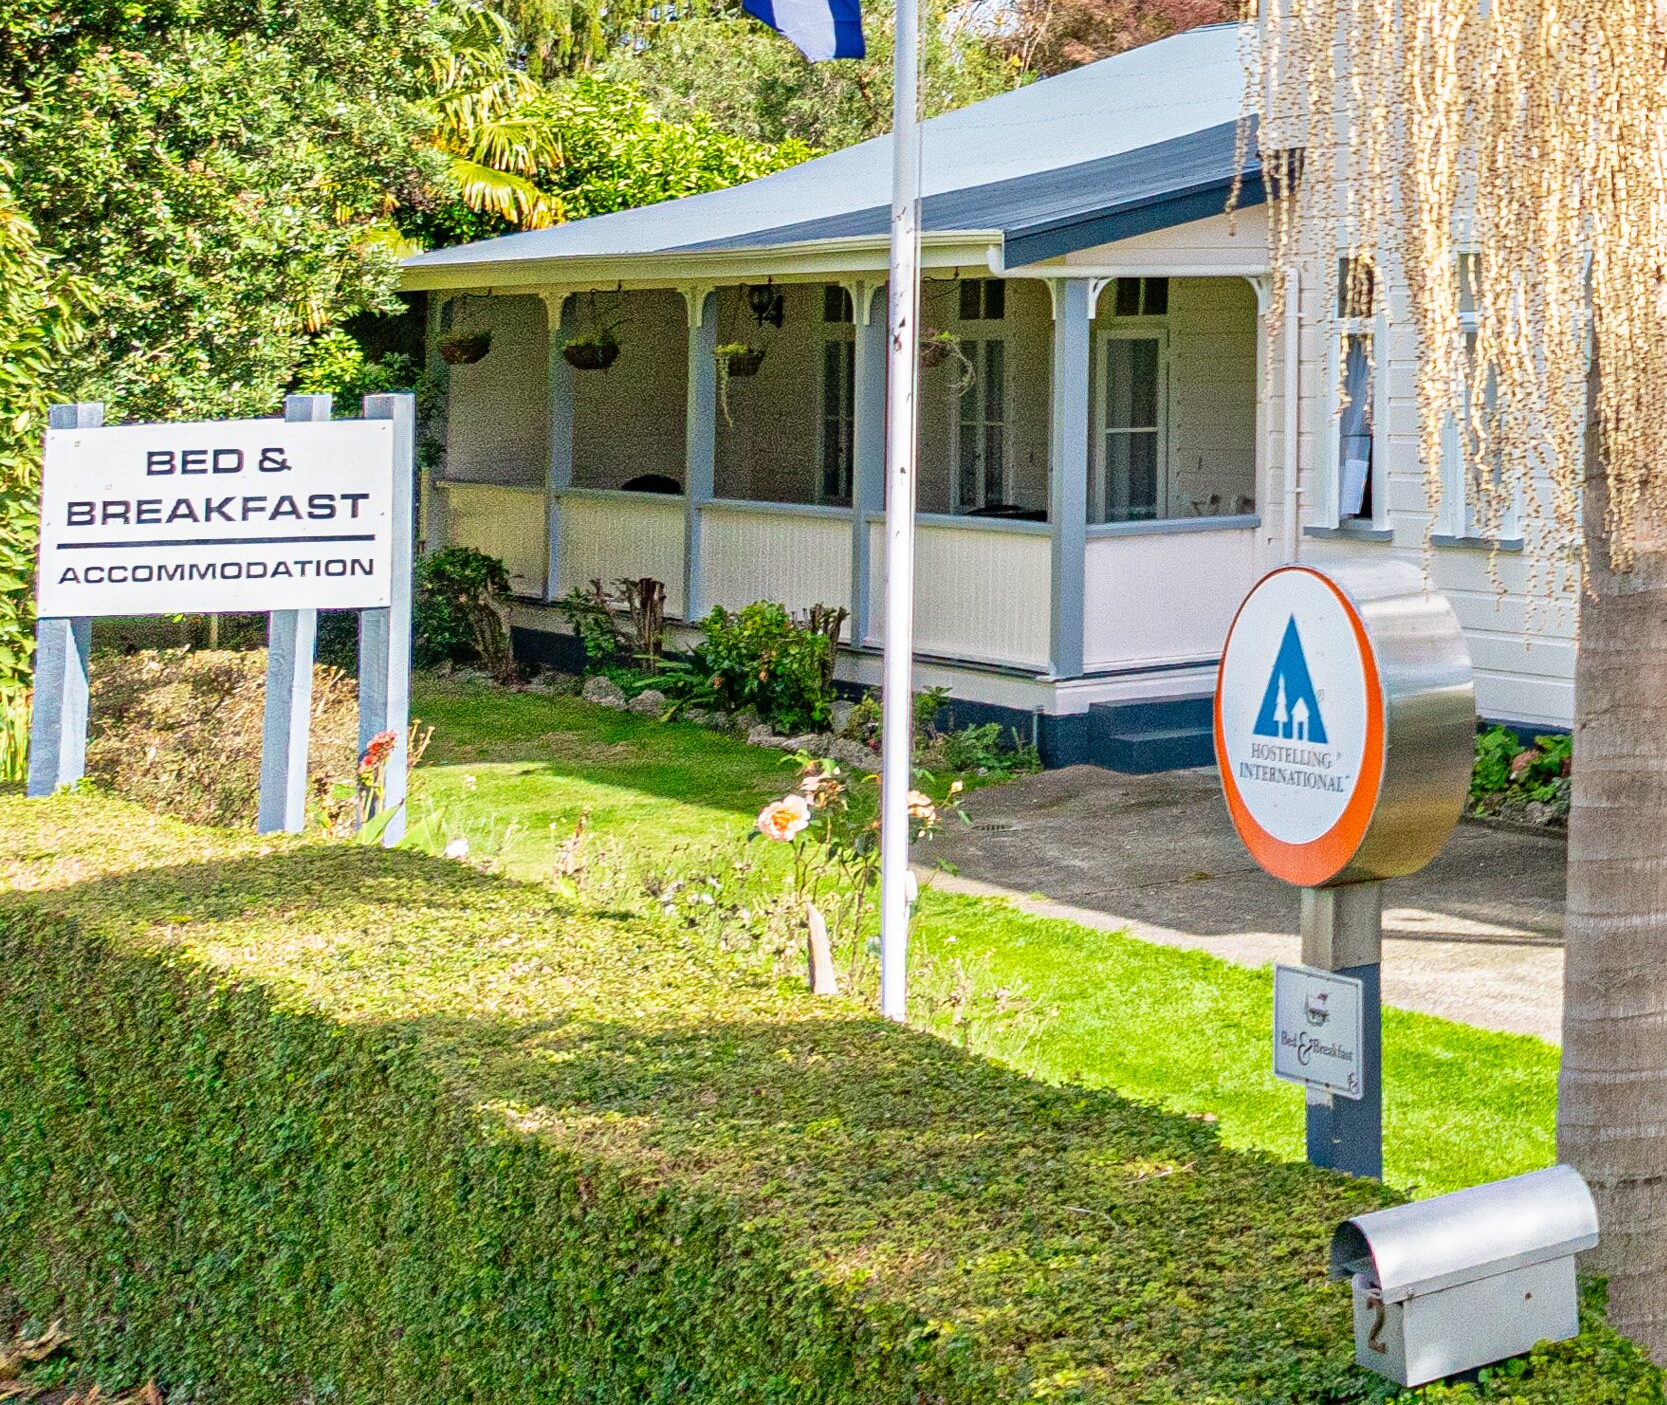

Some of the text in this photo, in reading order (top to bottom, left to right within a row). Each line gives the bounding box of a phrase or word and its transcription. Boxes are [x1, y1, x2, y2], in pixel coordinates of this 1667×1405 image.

[146, 447, 292, 476] BED &
[66, 493, 370, 527] BREAKFAST
[58, 559, 374, 584] ACCOMMODATION
[1251, 742, 1332, 769] HOSTELLING
[1239, 762, 1345, 792] INTERNATIONAL
[1366, 1297, 1388, 1354] 2
